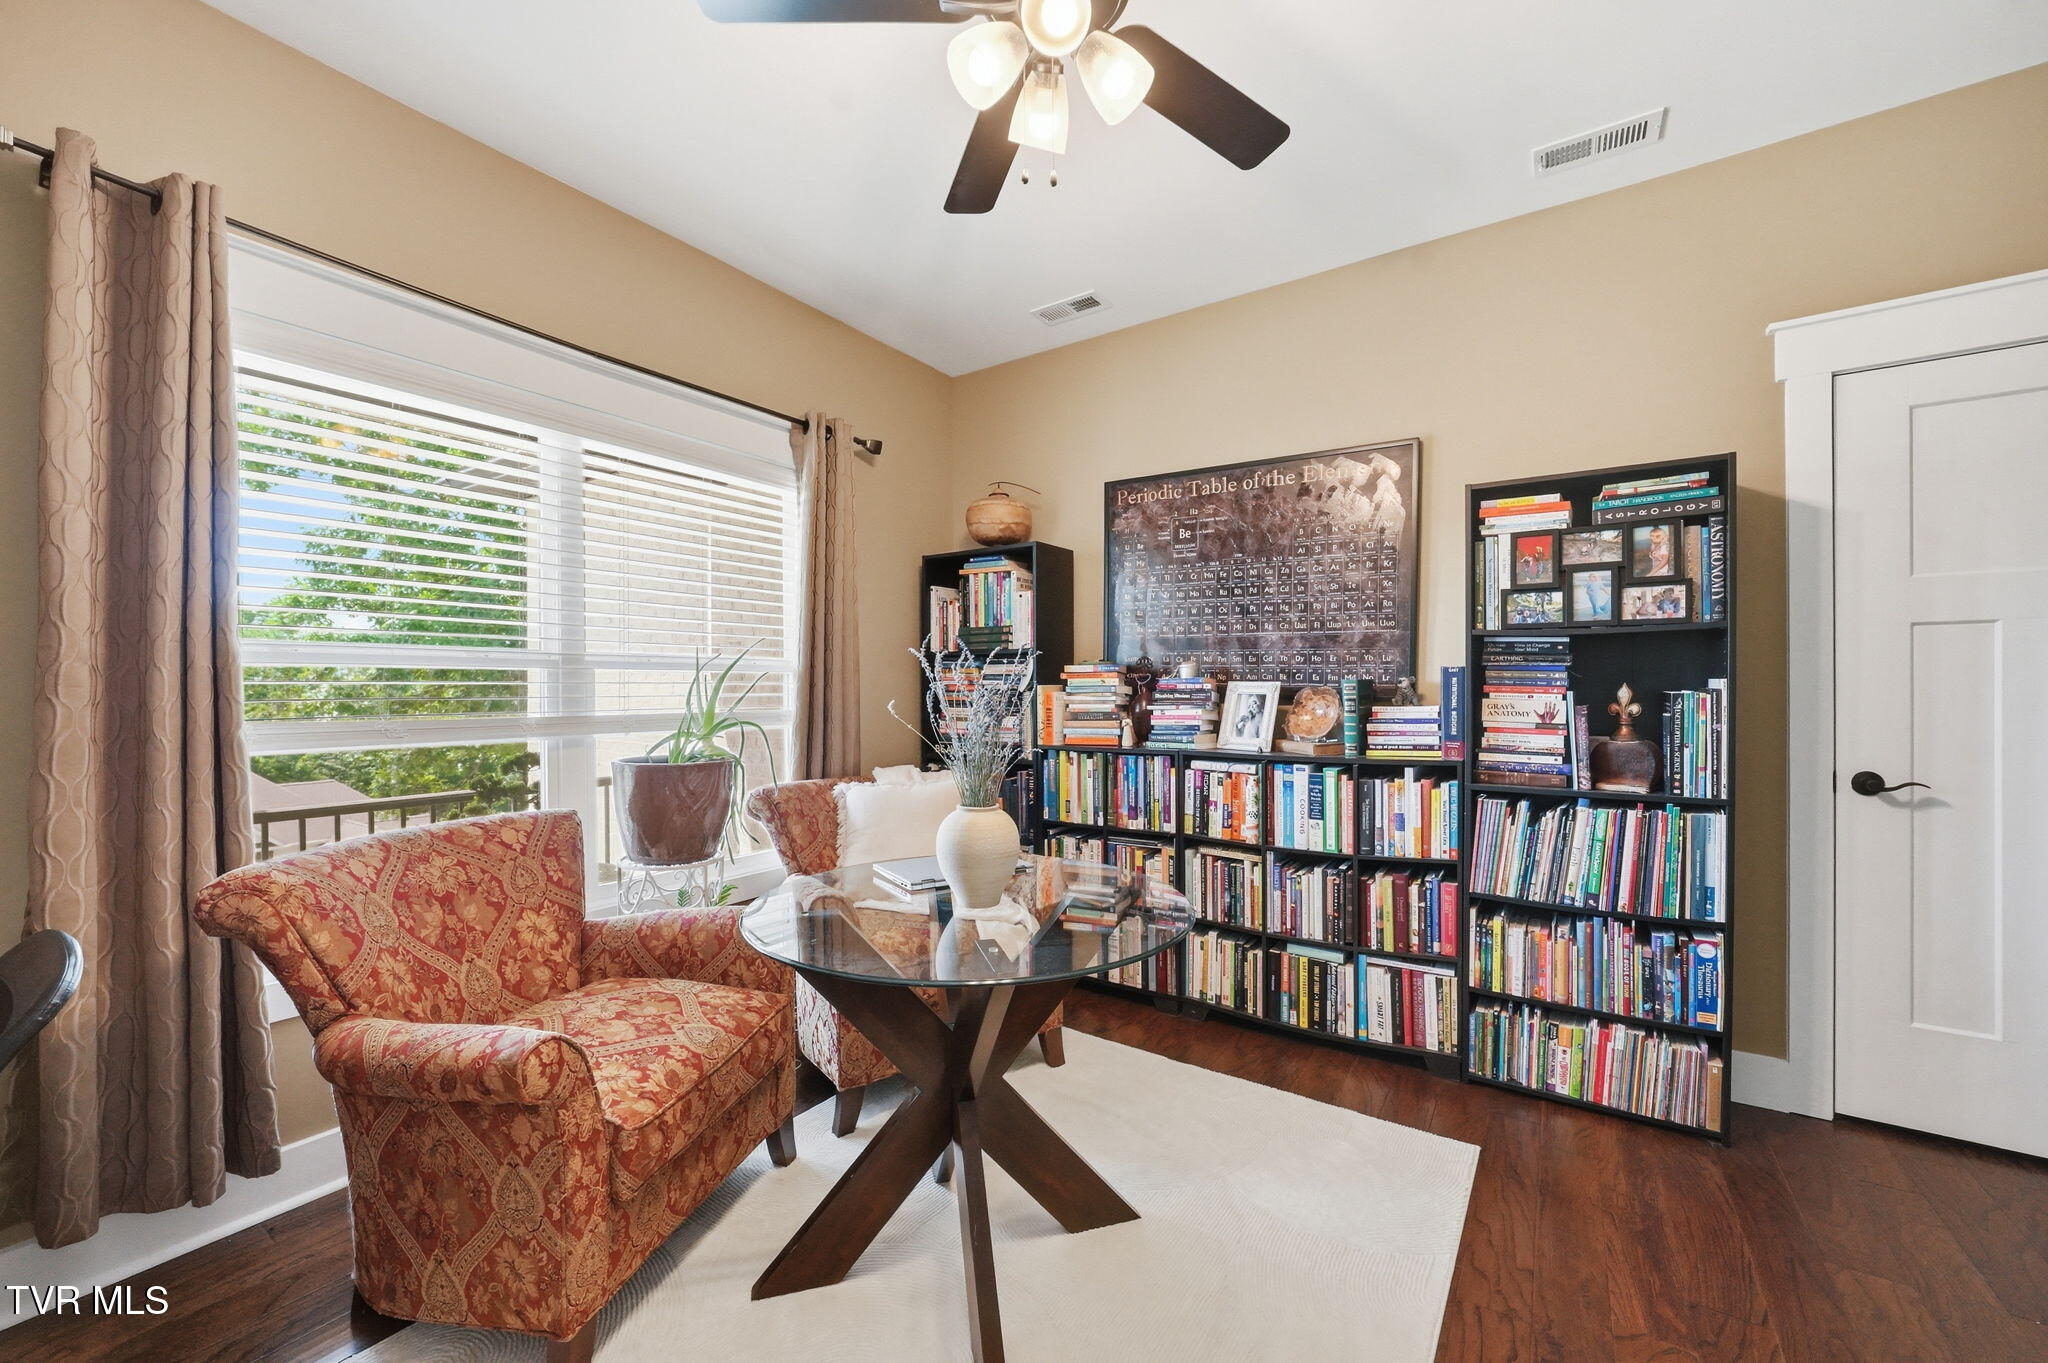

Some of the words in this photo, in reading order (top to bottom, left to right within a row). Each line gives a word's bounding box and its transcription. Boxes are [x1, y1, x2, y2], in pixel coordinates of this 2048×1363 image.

[1117, 484, 1182, 505] Periodic
[1187, 477, 1237, 497] Table
[1243, 472, 1262, 490] of
[1266, 469, 1295, 486] the
[1605, 503, 1708, 520] ASTROLOGY
[1608, 498, 1630, 507] TAROT
[1179, 529, 1191, 539] Be
[1711, 524, 1725, 601] ASTRONOMY
[1704, 962, 1712, 998] Dictionary
